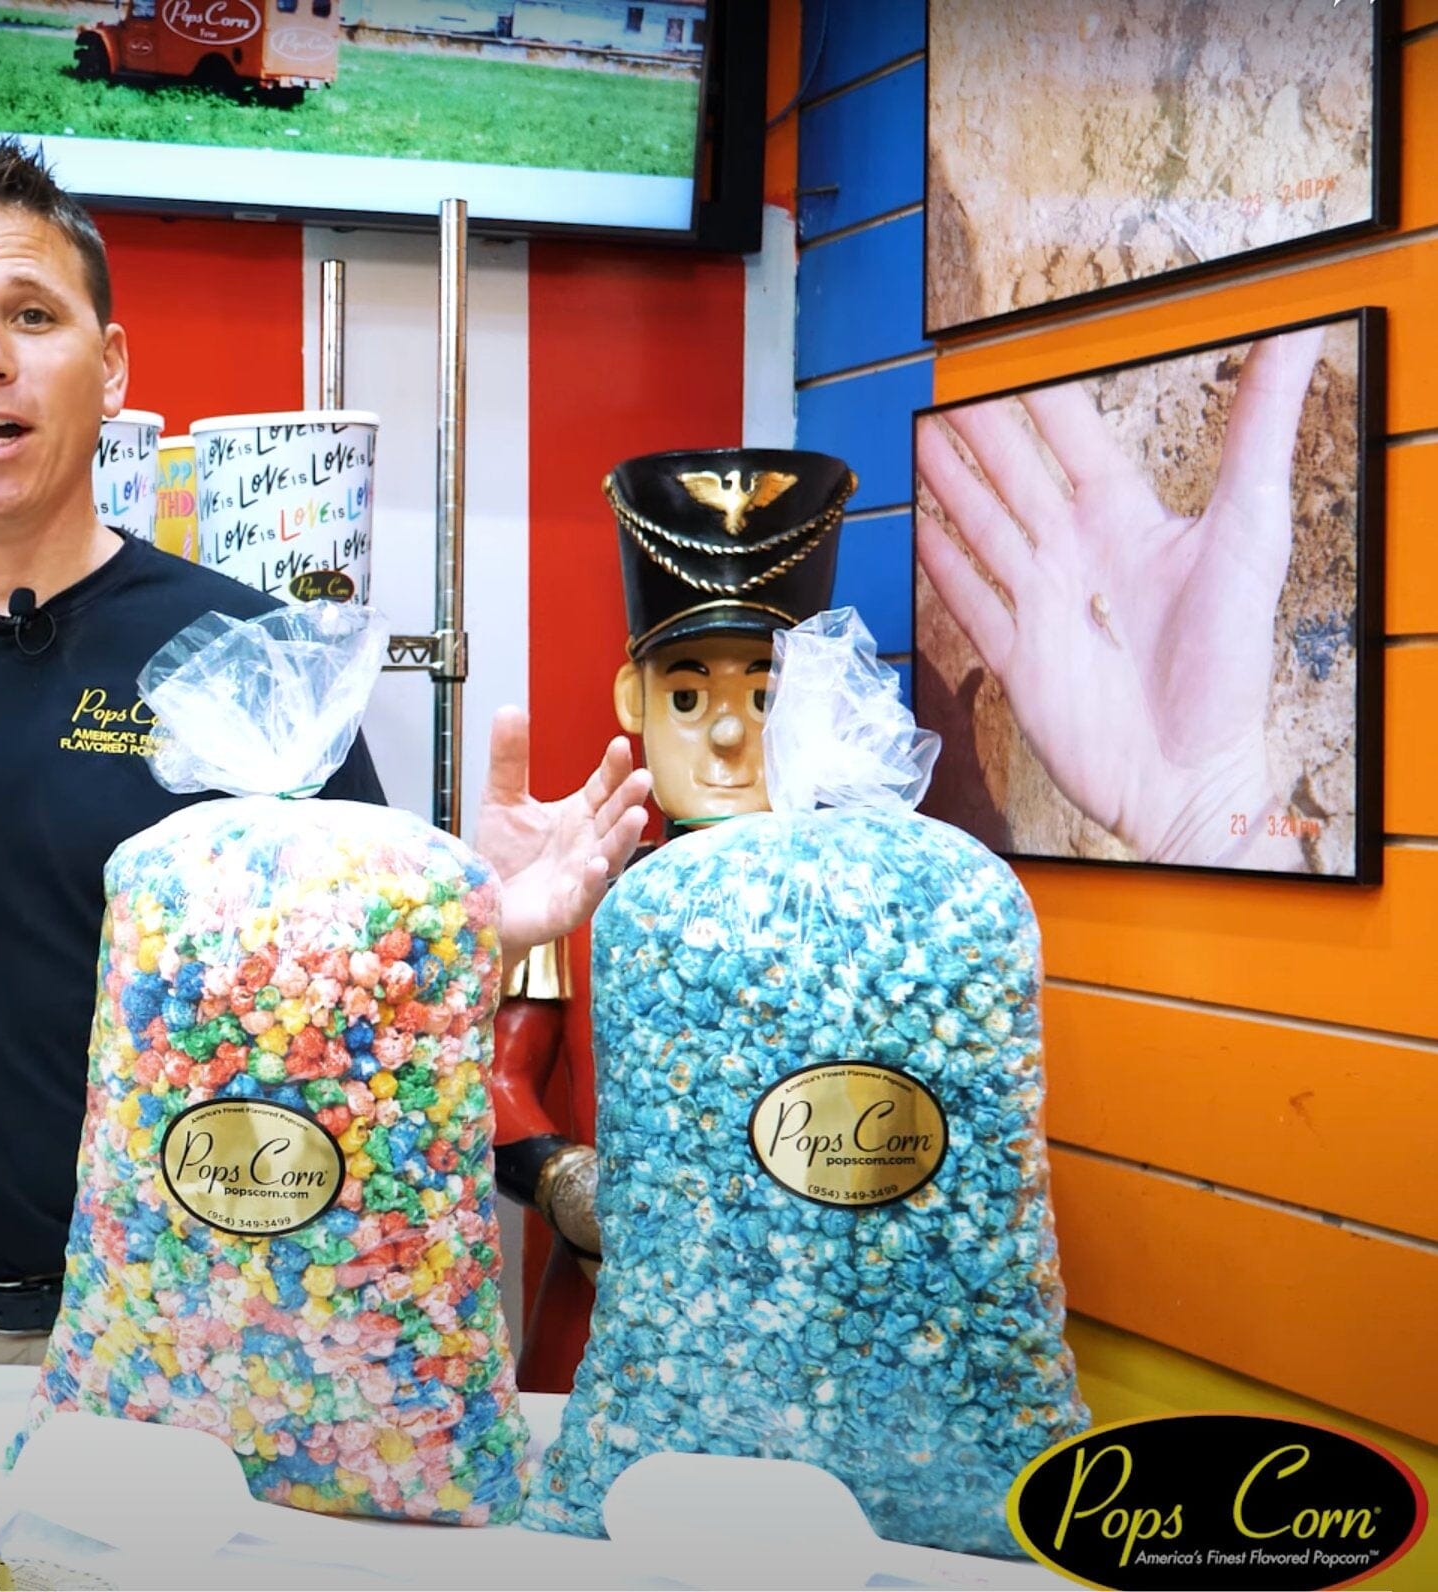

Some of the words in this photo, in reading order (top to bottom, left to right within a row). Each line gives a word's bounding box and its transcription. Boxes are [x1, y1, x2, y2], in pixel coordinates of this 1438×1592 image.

[169, 0, 203, 28] Pops
[205, 1, 250, 29] Corn
[71, 687, 127, 728] Pops
[60, 738, 127, 753] FLAVORED
[1231, 814, 1246, 835] 23
[822, 1070, 846, 1079] Finest
[769, 1100, 843, 1168] Pops
[176, 1130, 240, 1194] Pops
[826, 1156, 915, 1167] popscorn.com
[224, 1186, 309, 1199] popscorn.com
